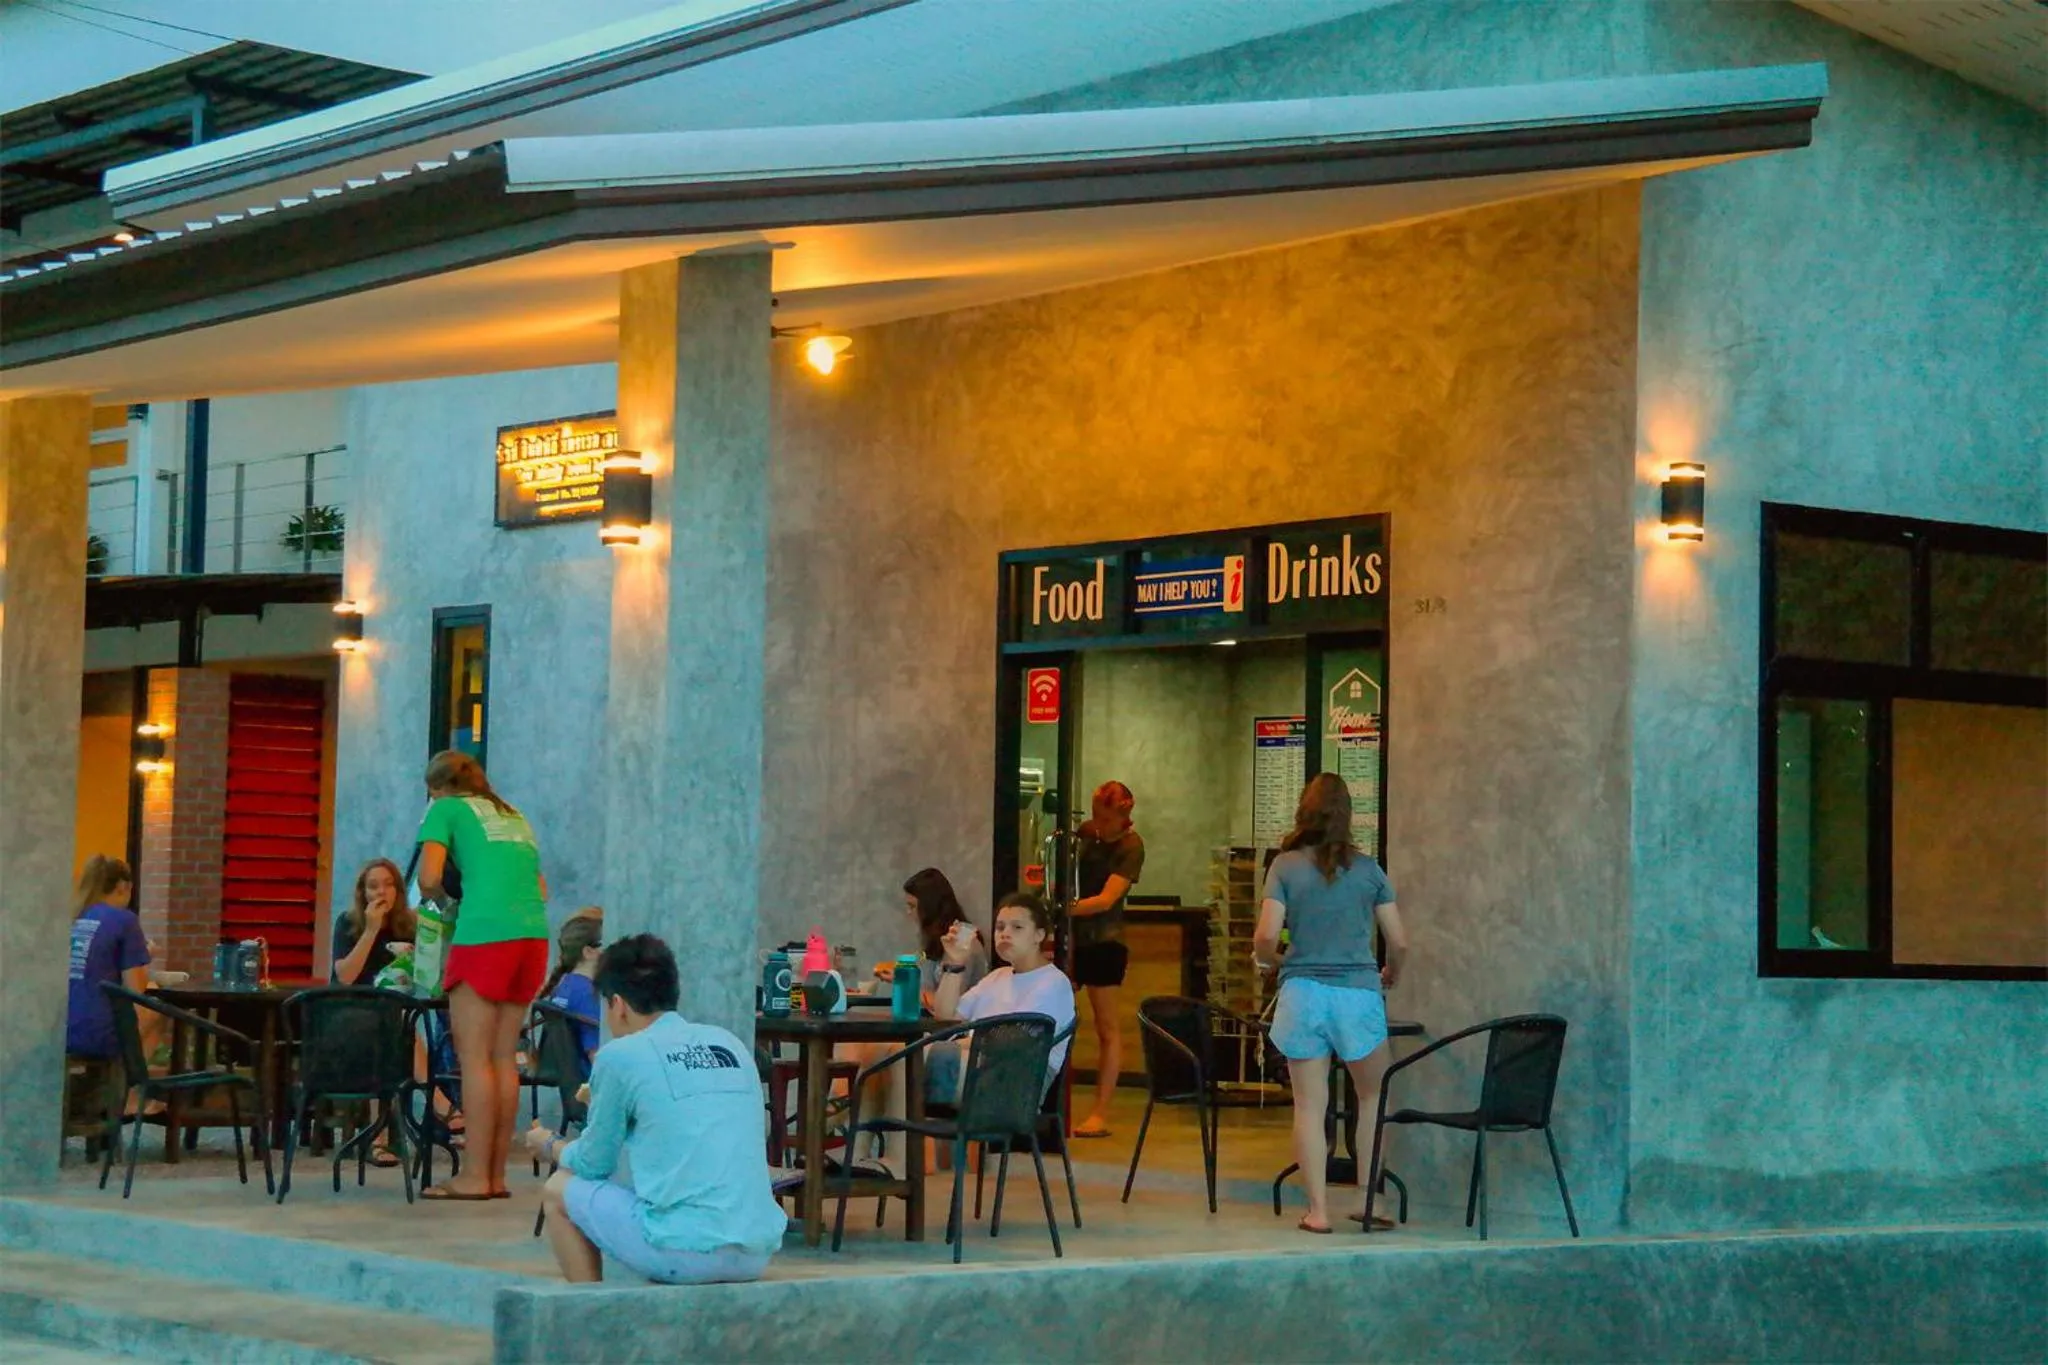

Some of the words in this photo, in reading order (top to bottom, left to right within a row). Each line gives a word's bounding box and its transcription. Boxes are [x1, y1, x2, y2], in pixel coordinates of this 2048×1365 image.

[1230, 558, 1244, 605] i
[1267, 534, 1382, 604] Drinks
[1032, 557, 1104, 626] Food
[1137, 583, 1158, 603] MAY
[1164, 580, 1188, 601] HELP
[666, 1051, 715, 1063] NORTH
[684, 1060, 719, 1071] FACE
